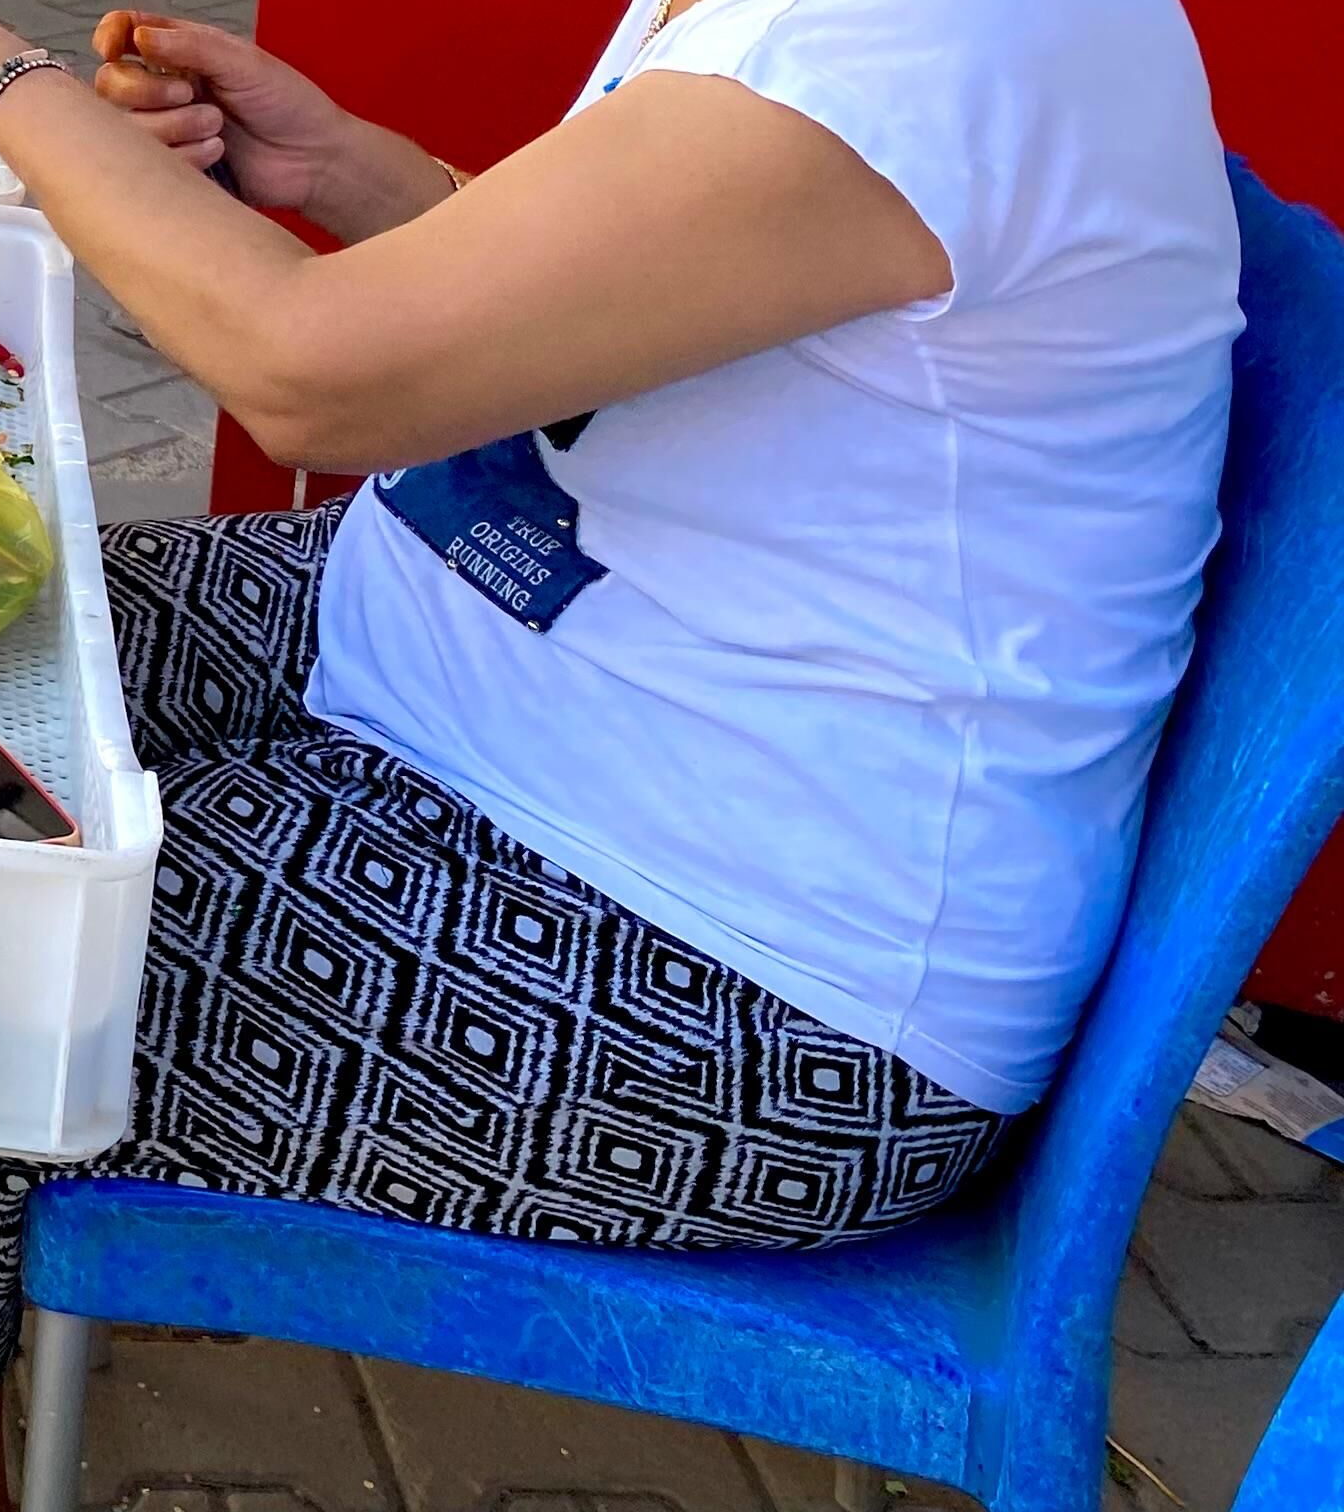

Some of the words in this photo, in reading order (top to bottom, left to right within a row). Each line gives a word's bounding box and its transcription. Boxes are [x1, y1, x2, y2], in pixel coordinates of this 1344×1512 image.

[470, 521, 552, 586] ORIGINS
[507, 515, 563, 557] TRUE
[445, 536, 532, 612] RUNNING
